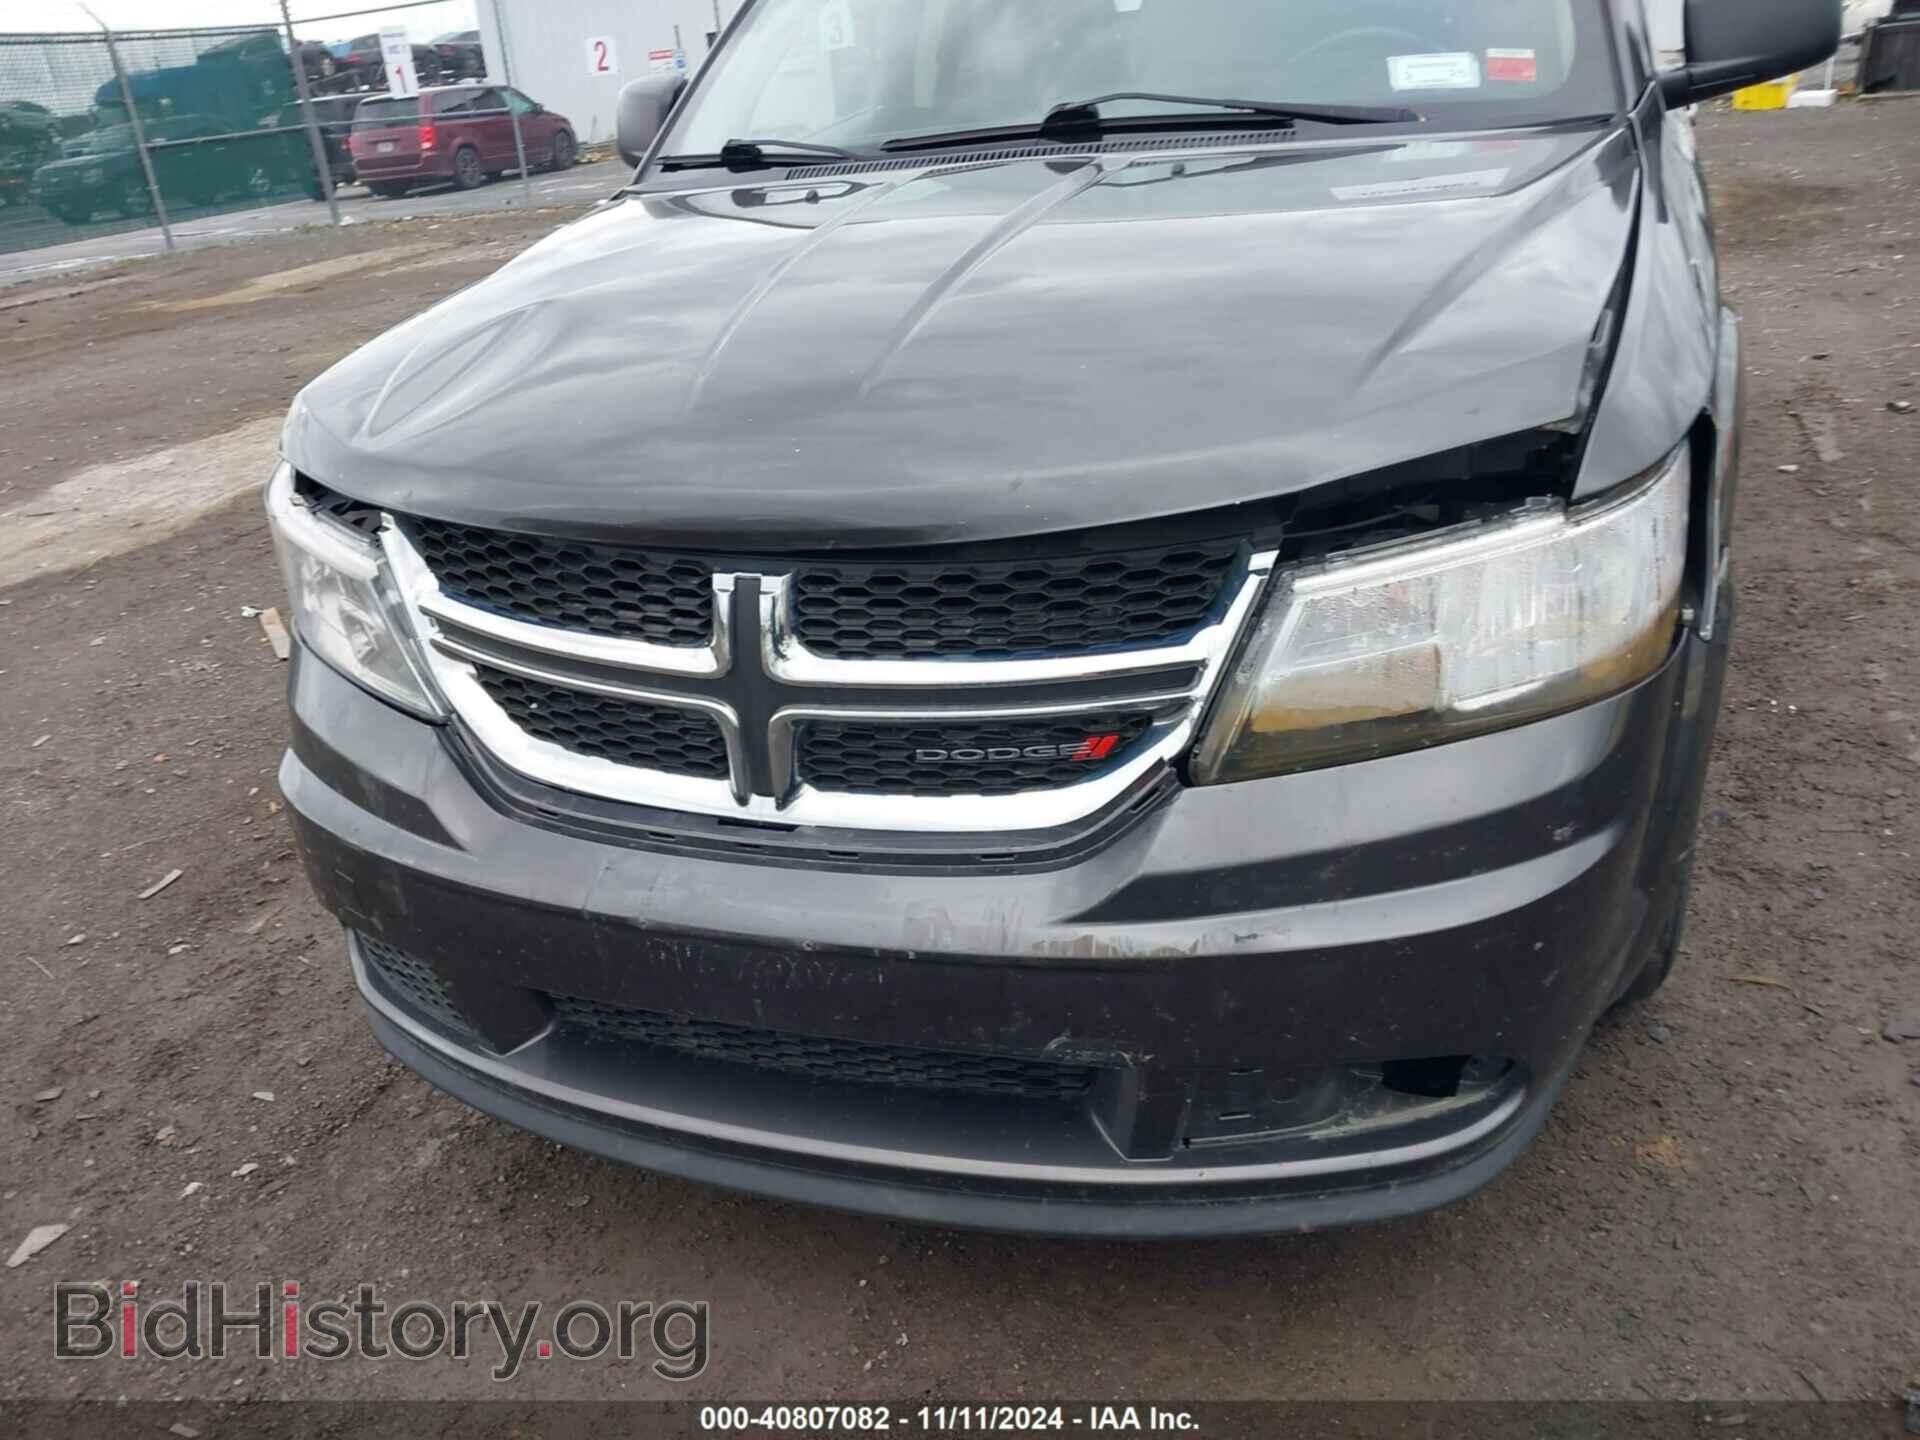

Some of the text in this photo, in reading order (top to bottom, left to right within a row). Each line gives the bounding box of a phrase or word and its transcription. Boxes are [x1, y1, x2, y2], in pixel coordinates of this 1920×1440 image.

[593, 40, 609, 71] 2
[395, 64, 408, 94] 1
[915, 744, 1091, 761] DODGE
